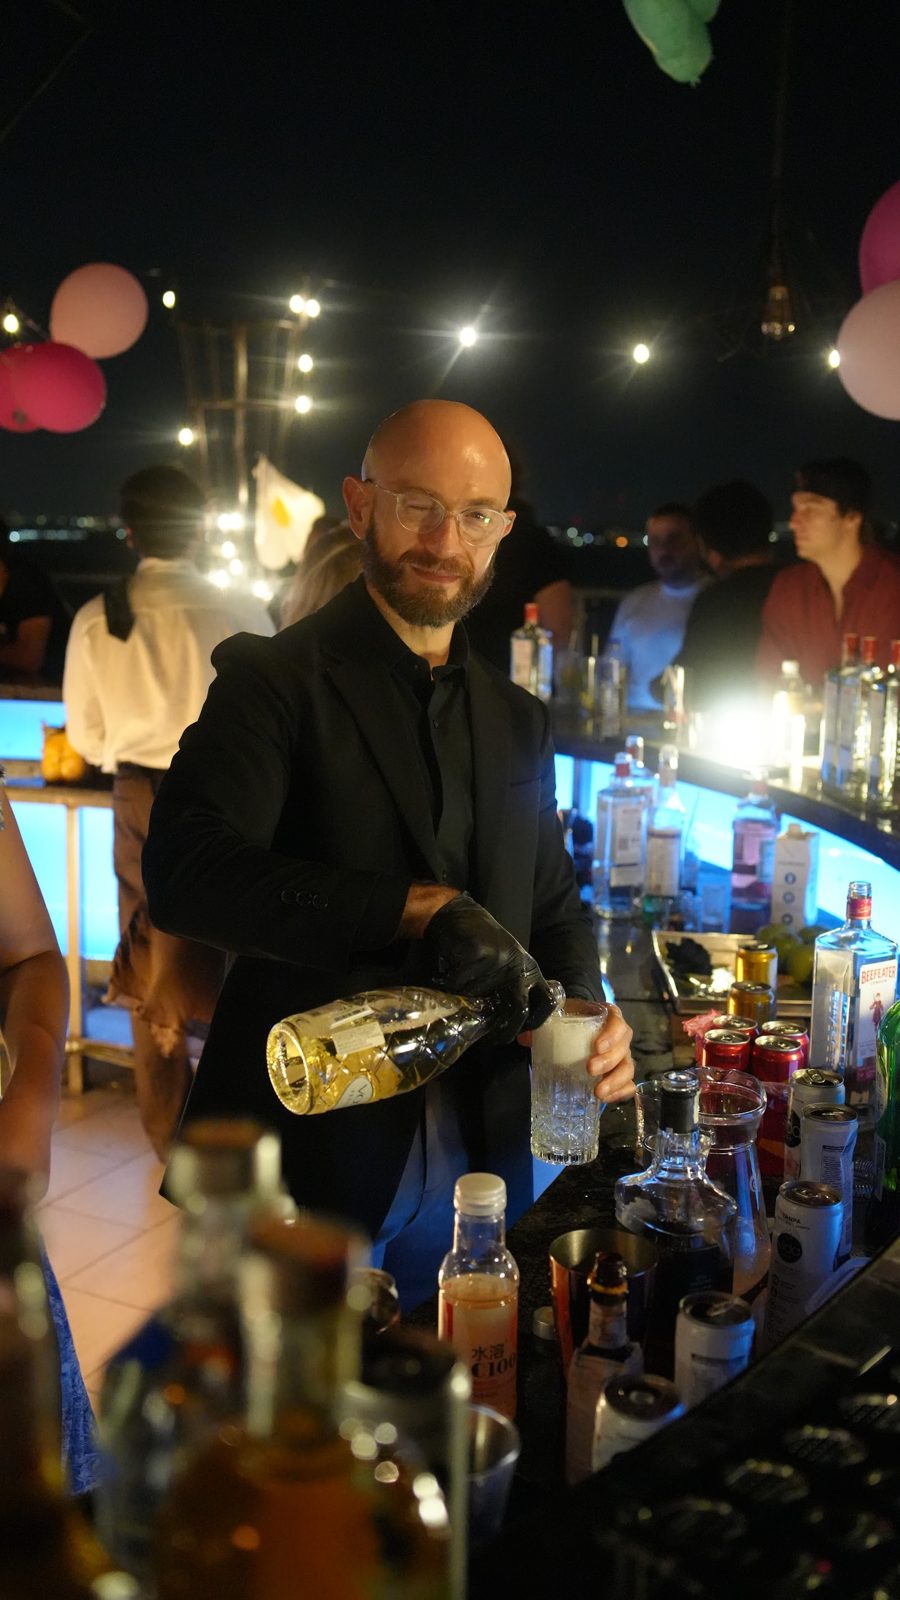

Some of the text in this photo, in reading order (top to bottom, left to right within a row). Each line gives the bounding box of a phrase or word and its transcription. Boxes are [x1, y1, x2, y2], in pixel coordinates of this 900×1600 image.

[861, 965, 896, 984] BEEFEATER
[472, 1344, 504, 1360] 水溶
[472, 1352, 516, 1377] C100
